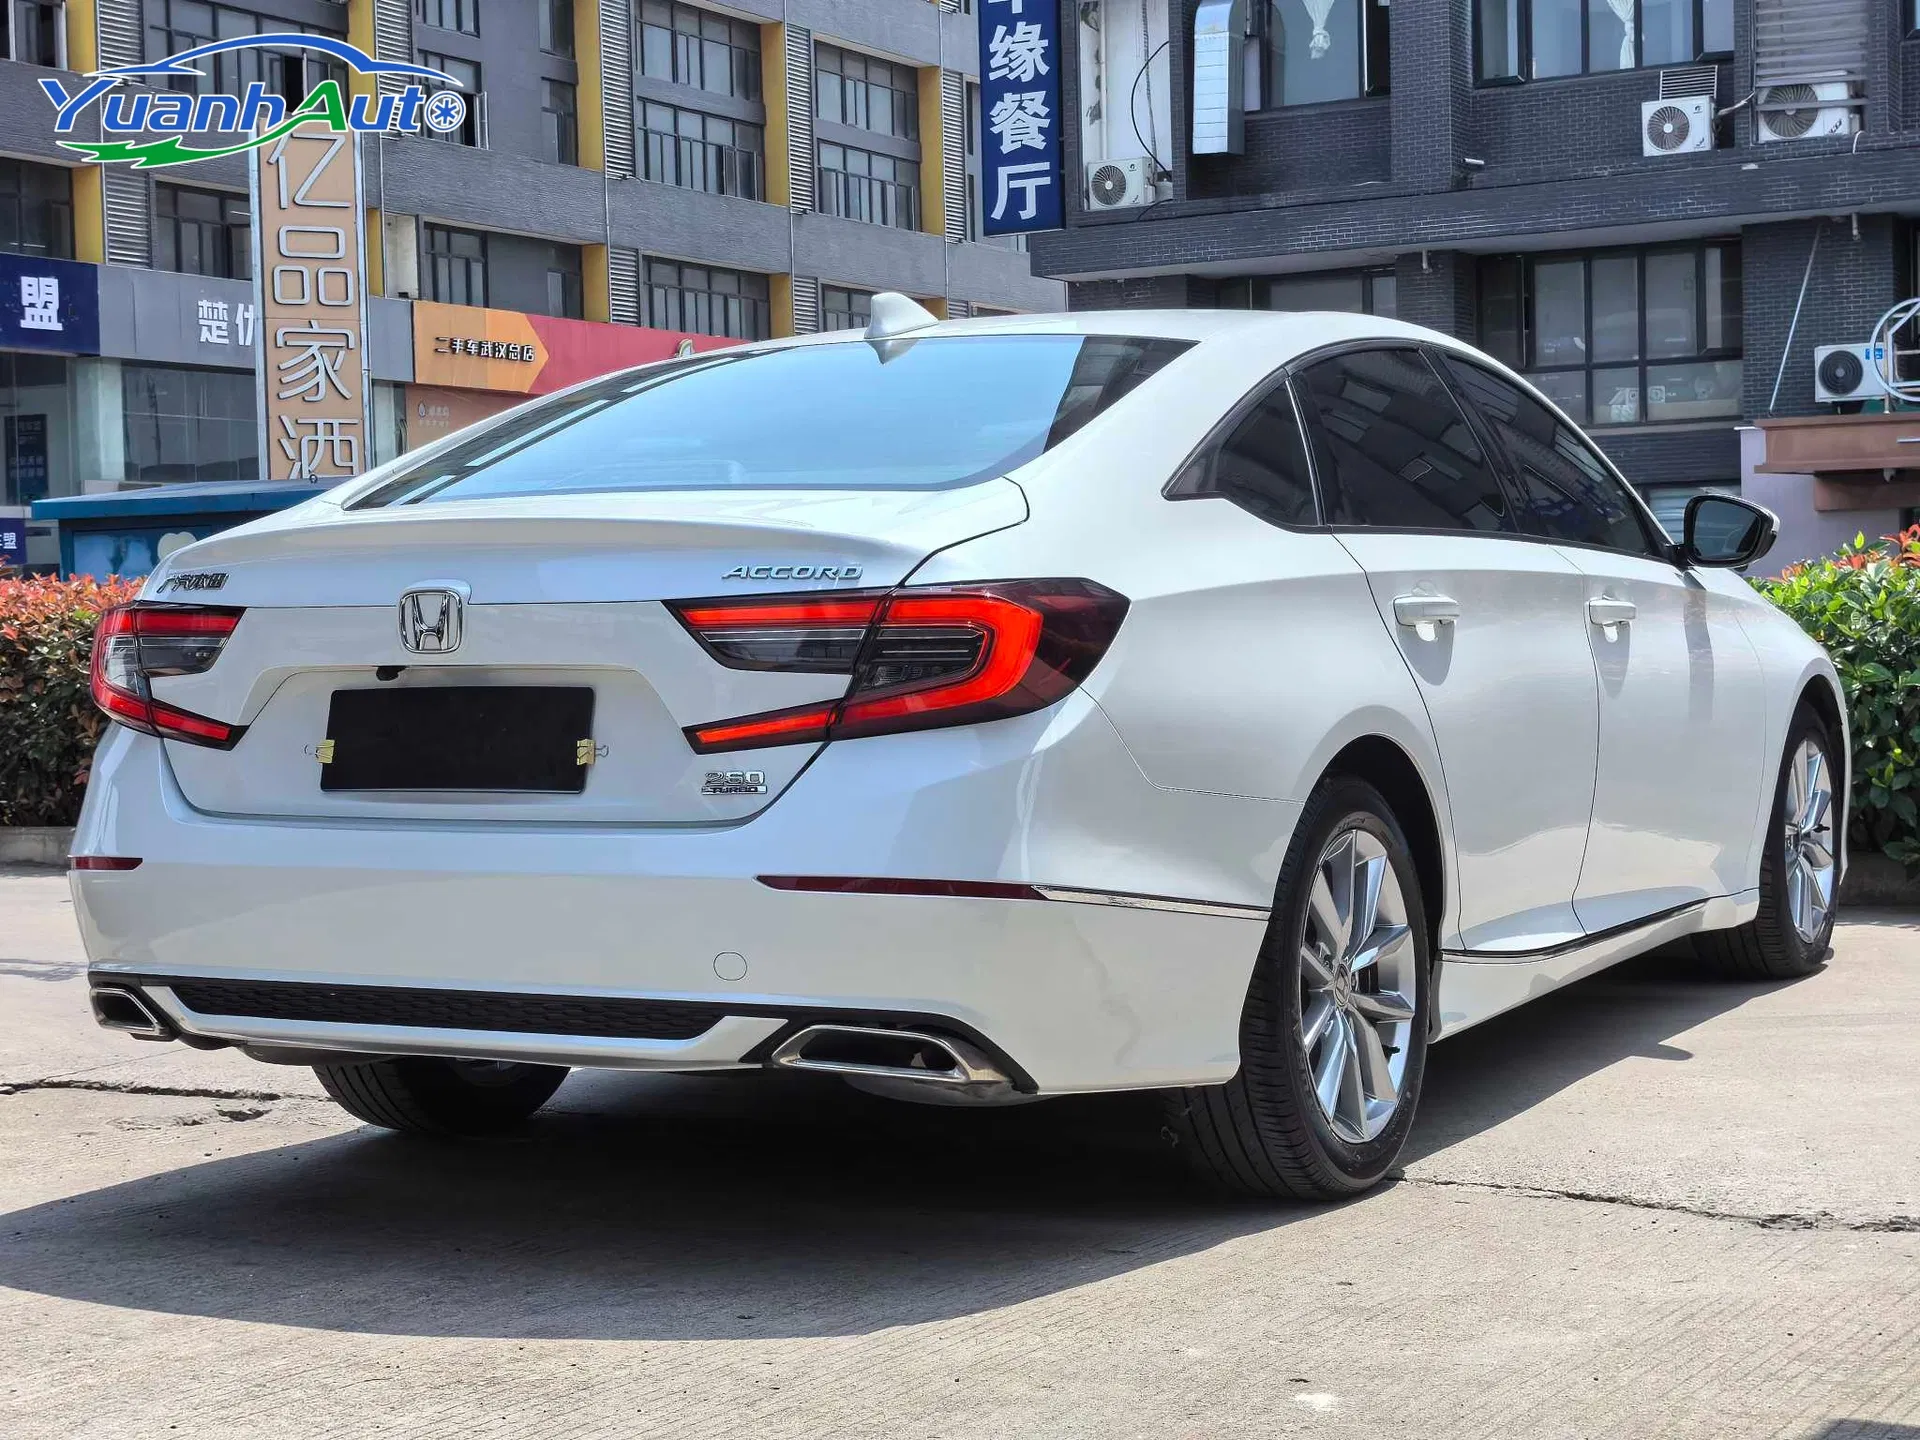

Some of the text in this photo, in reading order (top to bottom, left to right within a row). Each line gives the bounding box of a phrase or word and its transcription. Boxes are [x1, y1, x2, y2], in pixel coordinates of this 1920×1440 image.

[20, 276, 63, 331] 盟
[434, 336, 536, 362] 二手车武汉总店
[721, 564, 864, 580] ACCORD
[157, 573, 230, 594] 广汽本田
[704, 770, 765, 786] 260
